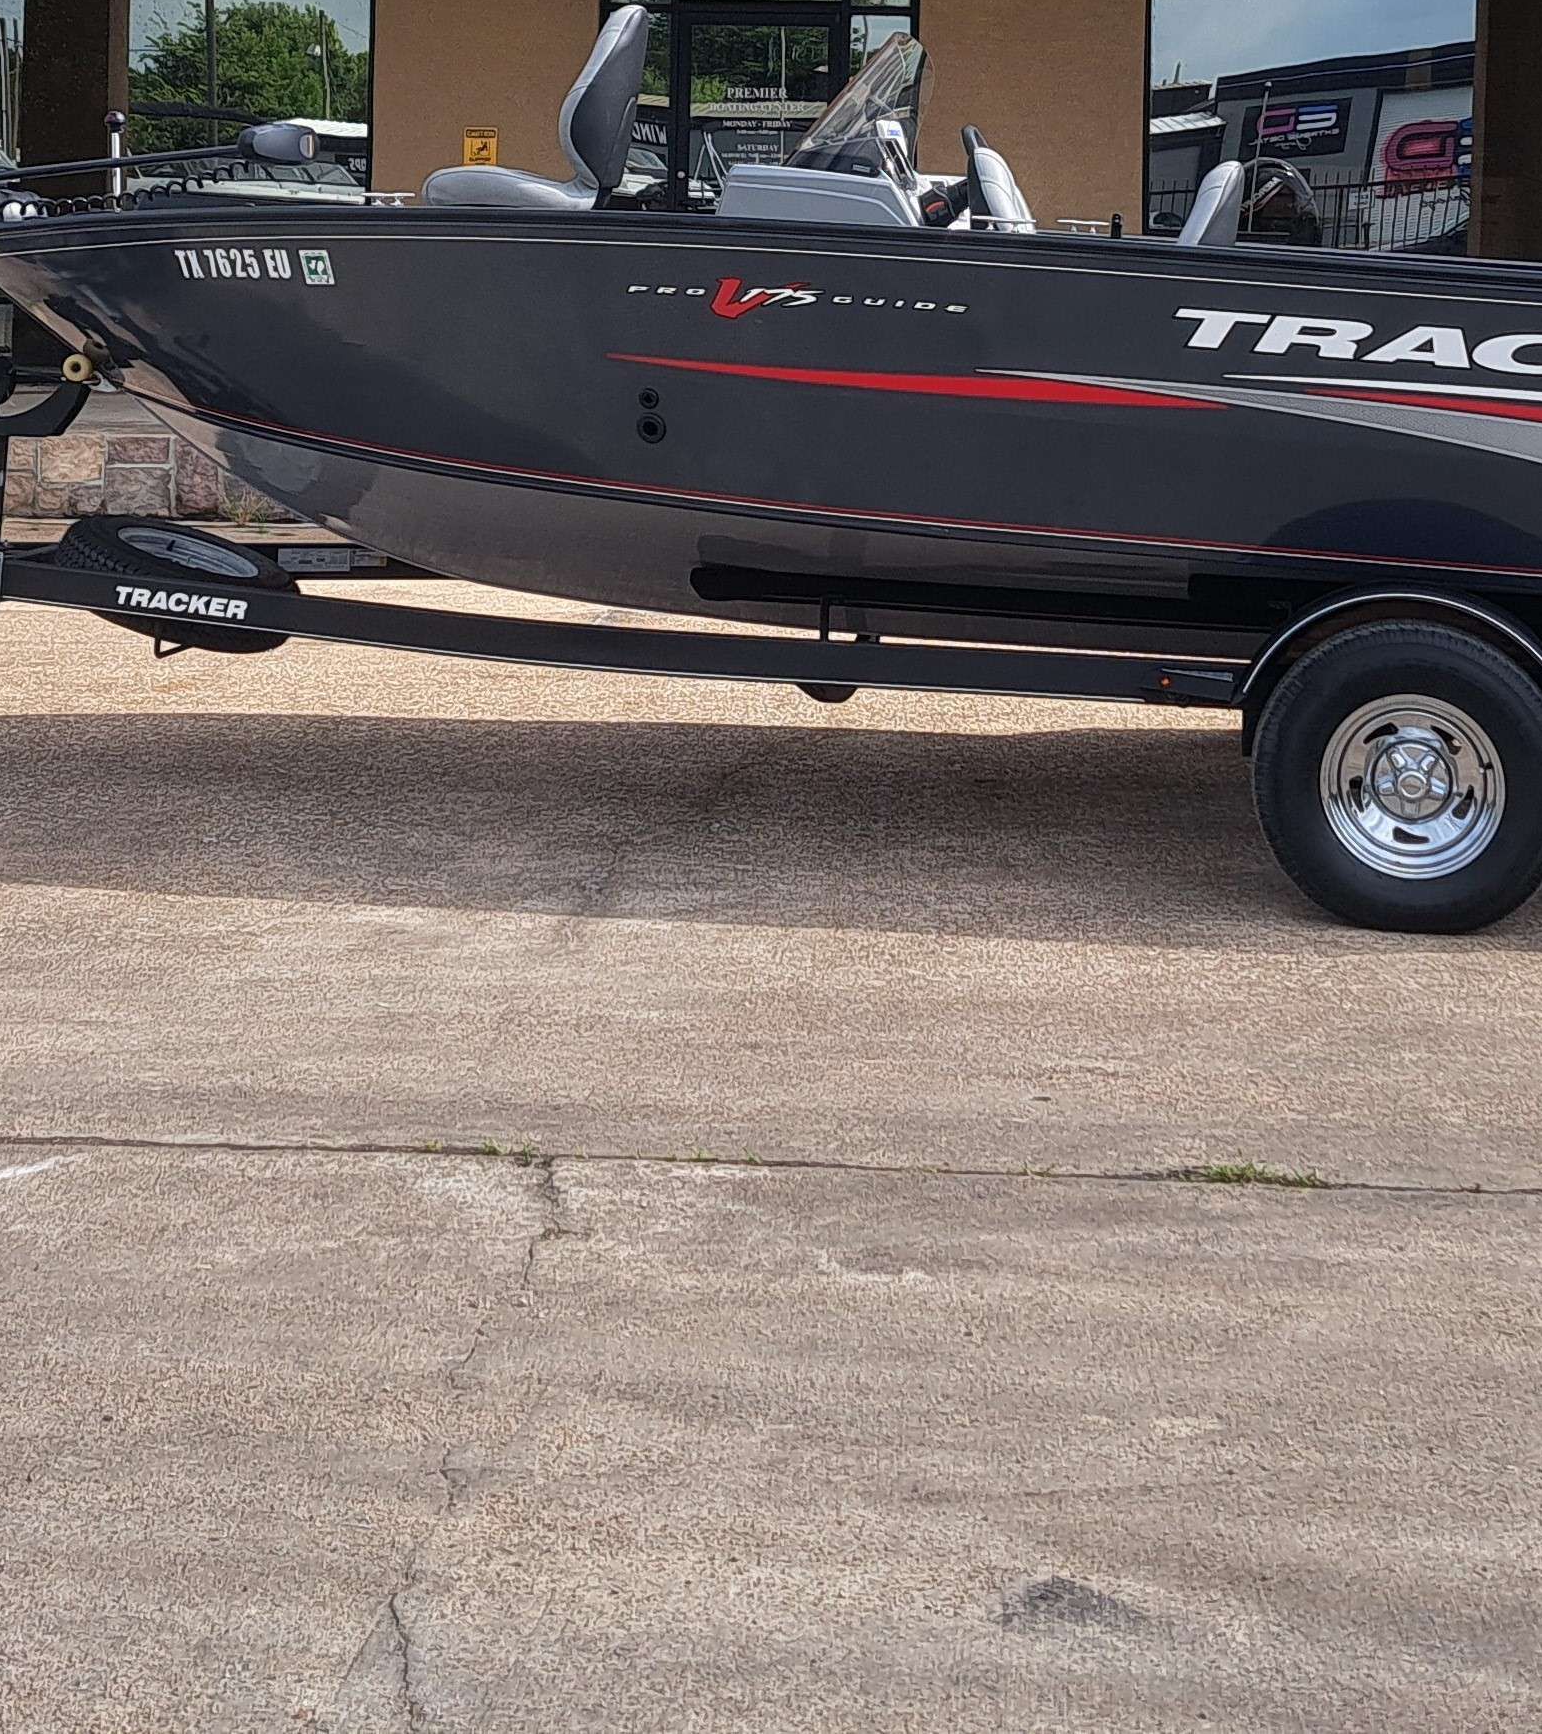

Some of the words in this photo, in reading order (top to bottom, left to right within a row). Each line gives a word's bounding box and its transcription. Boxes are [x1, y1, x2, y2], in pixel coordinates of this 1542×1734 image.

[726, 87, 788, 100] PREMIER
[722, 120, 756, 128] MONDAY
[737, 144, 779, 152] SATURDAY
[174, 249, 205, 279] TX
[262, 249, 292, 279] EU
[627, 285, 705, 295] PRO
[832, 295, 969, 314] GUIDE
[115, 585, 249, 620] TRACKER
